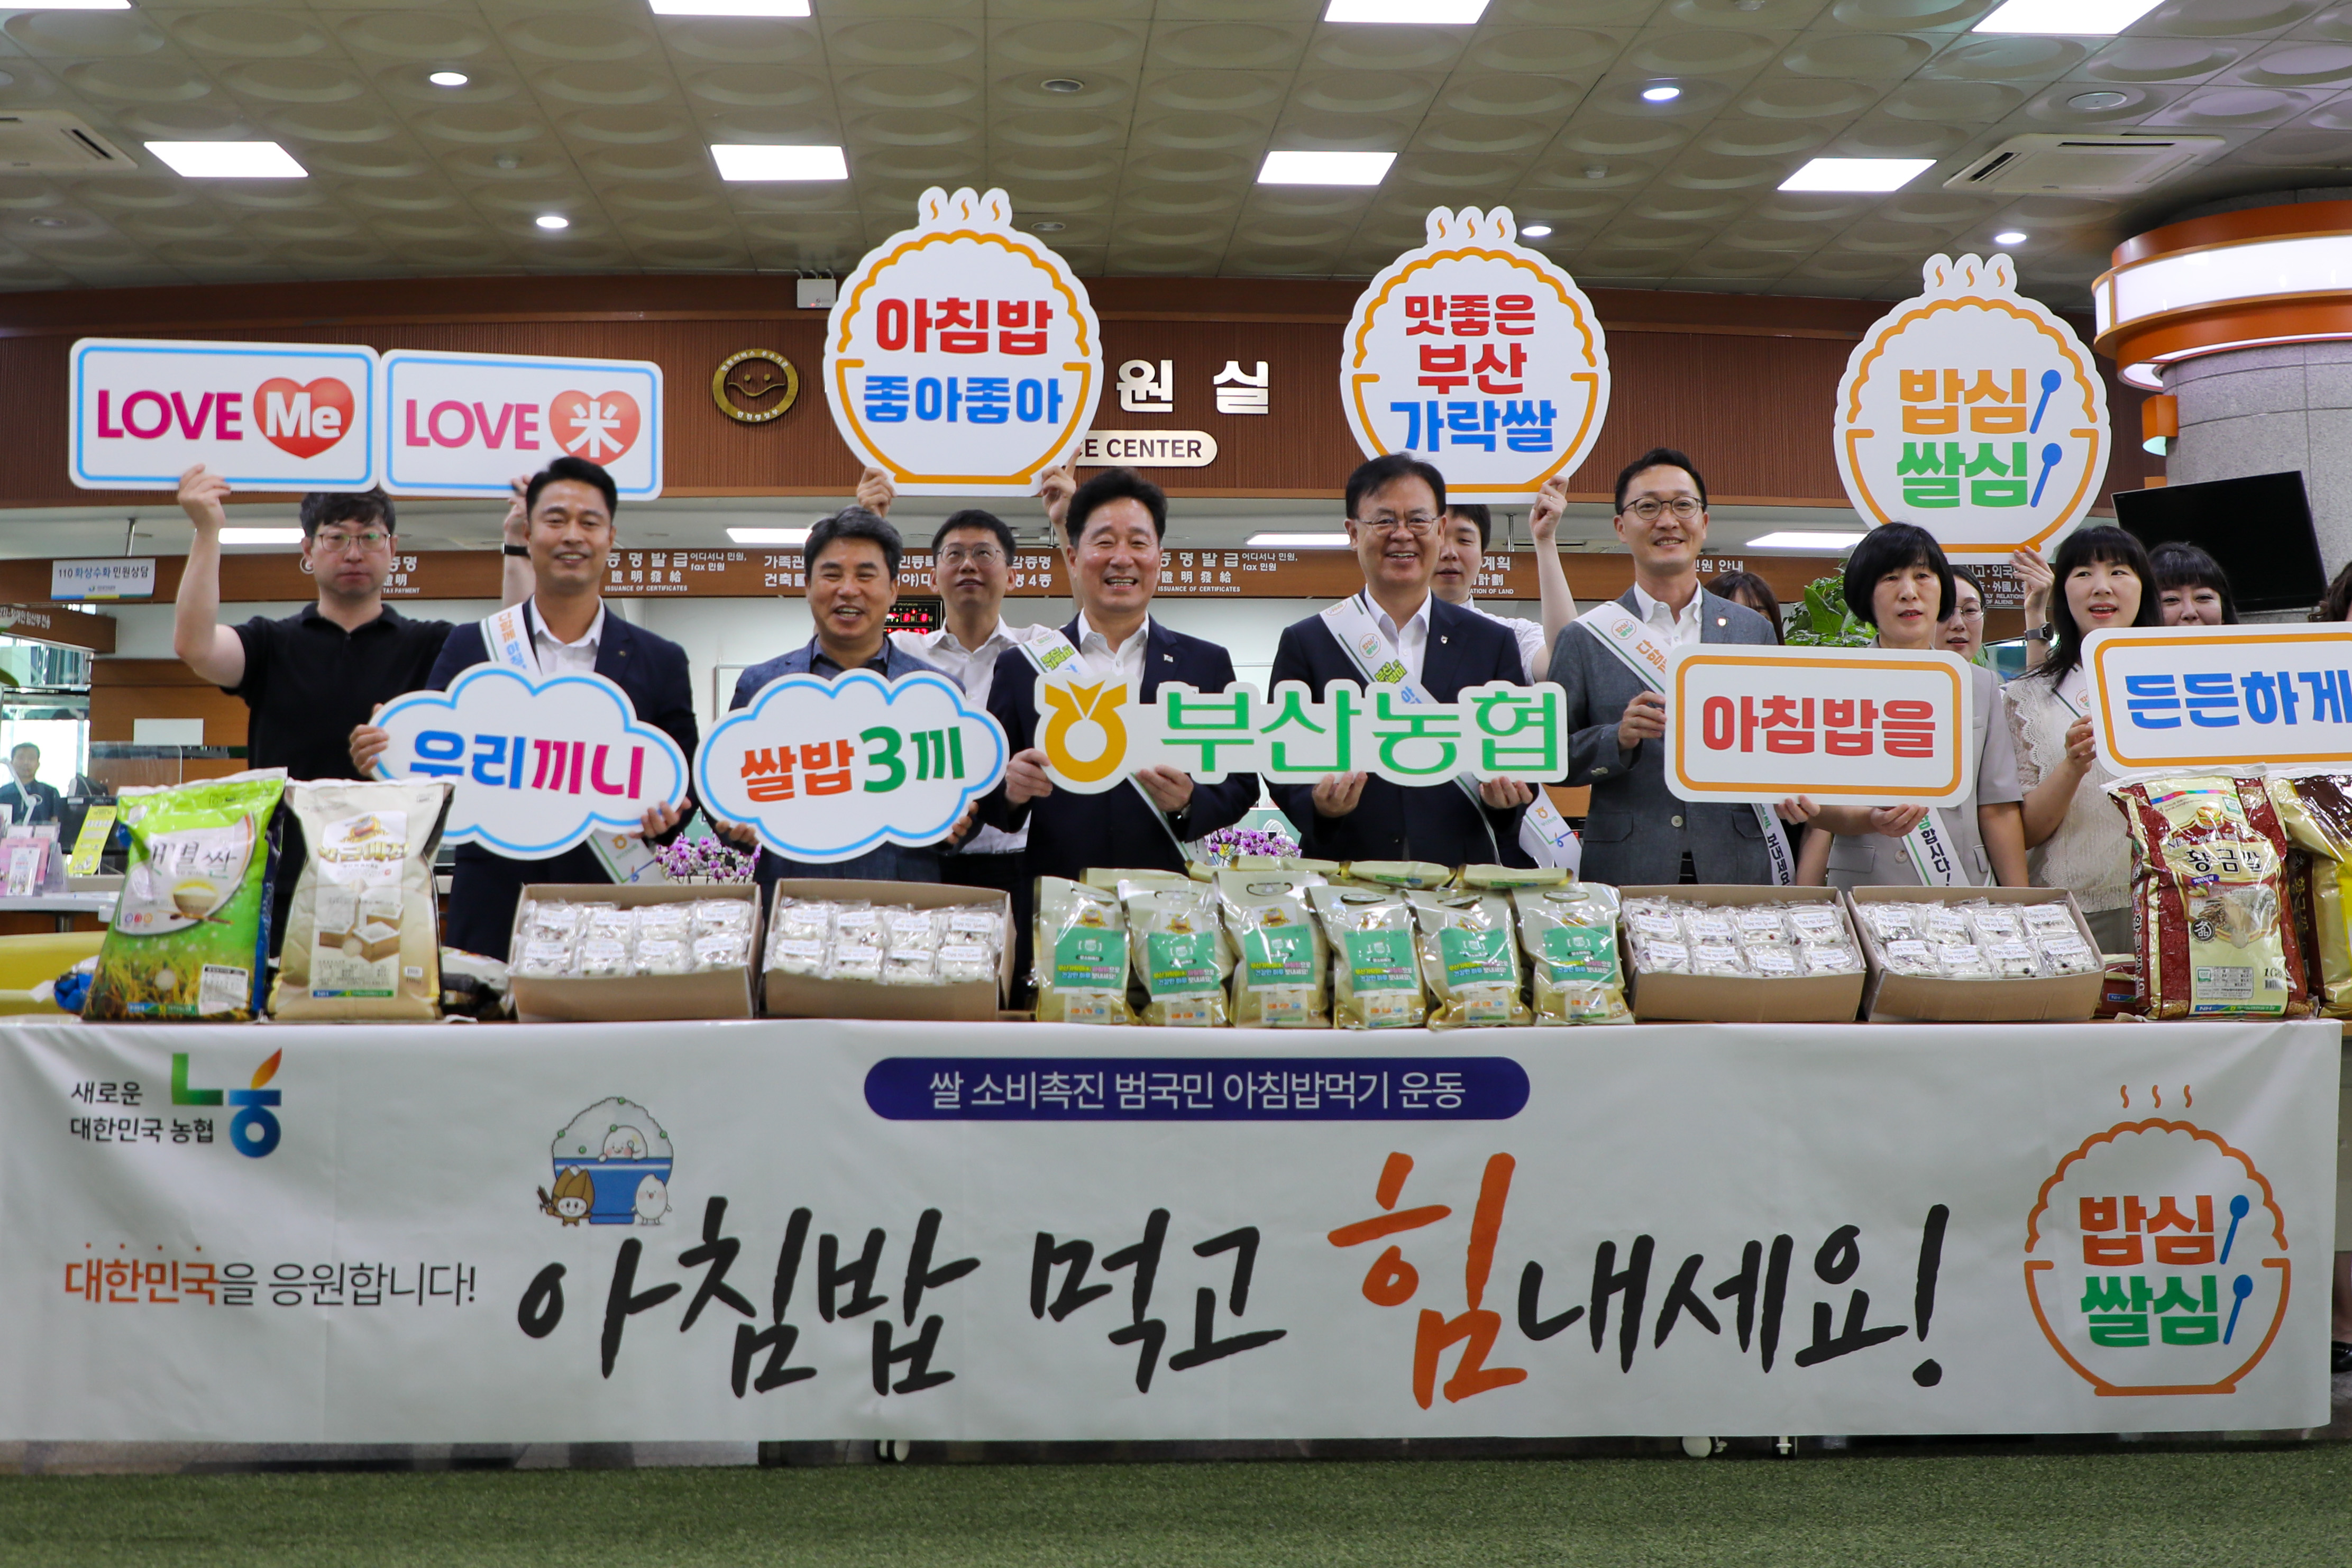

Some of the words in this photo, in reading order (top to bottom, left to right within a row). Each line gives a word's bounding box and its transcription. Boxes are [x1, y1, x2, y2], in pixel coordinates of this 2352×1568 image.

[876, 297, 1053, 355] 아침밥
[1405, 294, 1535, 336] 맛좋은
[1418, 343, 1527, 395] 부산
[98, 390, 243, 440] LOVE
[266, 391, 342, 438] Me
[864, 375, 1063, 423] 좋아좋아
[1900, 369, 2027, 435] 밥심
[406, 399, 540, 450] LOVE
[565, 401, 625, 458] 米
[1105, 438, 1202, 459] CENTER
[1390, 400, 1557, 453] 가락쌀
[1897, 442, 2027, 508] 쌀심
[59, 568, 73, 577] 110
[75, 566, 111, 579] 화상수화
[113, 565, 149, 578] 민원상담
[690, 552, 724, 562] 어디서나
[708, 562, 725, 572] 민원
[1028, 574, 1037, 586] 4
[1039, 574, 1051, 588] 종
[1242, 553, 1276, 562] 어디서나
[1242, 563, 1257, 572] fax
[1260, 563, 1277, 572] 민원
[1473, 573, 1504, 586] 計劃
[1481, 555, 1511, 571] 계획
[1718, 559, 1744, 573] 안내
[2125, 670, 2352, 730] 든든하게
[1160, 690, 1559, 775] 부산농협
[1703, 695, 1936, 758] 아침밥을
[409, 730, 646, 800] 우리끼니
[71, 1081, 143, 1107] 새로운
[929, 1070, 964, 1109] 쌀
[971, 1071, 1104, 1110] 소비촉진
[1115, 1071, 1214, 1110] 범국민
[1222, 1070, 1389, 1110] 아침밥먹기
[1398, 1071, 1466, 1110] 운동
[70, 1117, 164, 1143] 대한민국
[170, 1118, 214, 1144] 농협
[2080, 1195, 2215, 1266] 밥심
[65, 1259, 258, 1306] 대한민국을
[268, 1262, 477, 1306] 응원합니다!
[518, 1196, 980, 1398] 아침밥
[1029, 1208, 1288, 1394] 먹고
[1327, 1151, 1950, 1410] 힘내세요!
[2081, 1275, 2219, 1347] 쌀심
